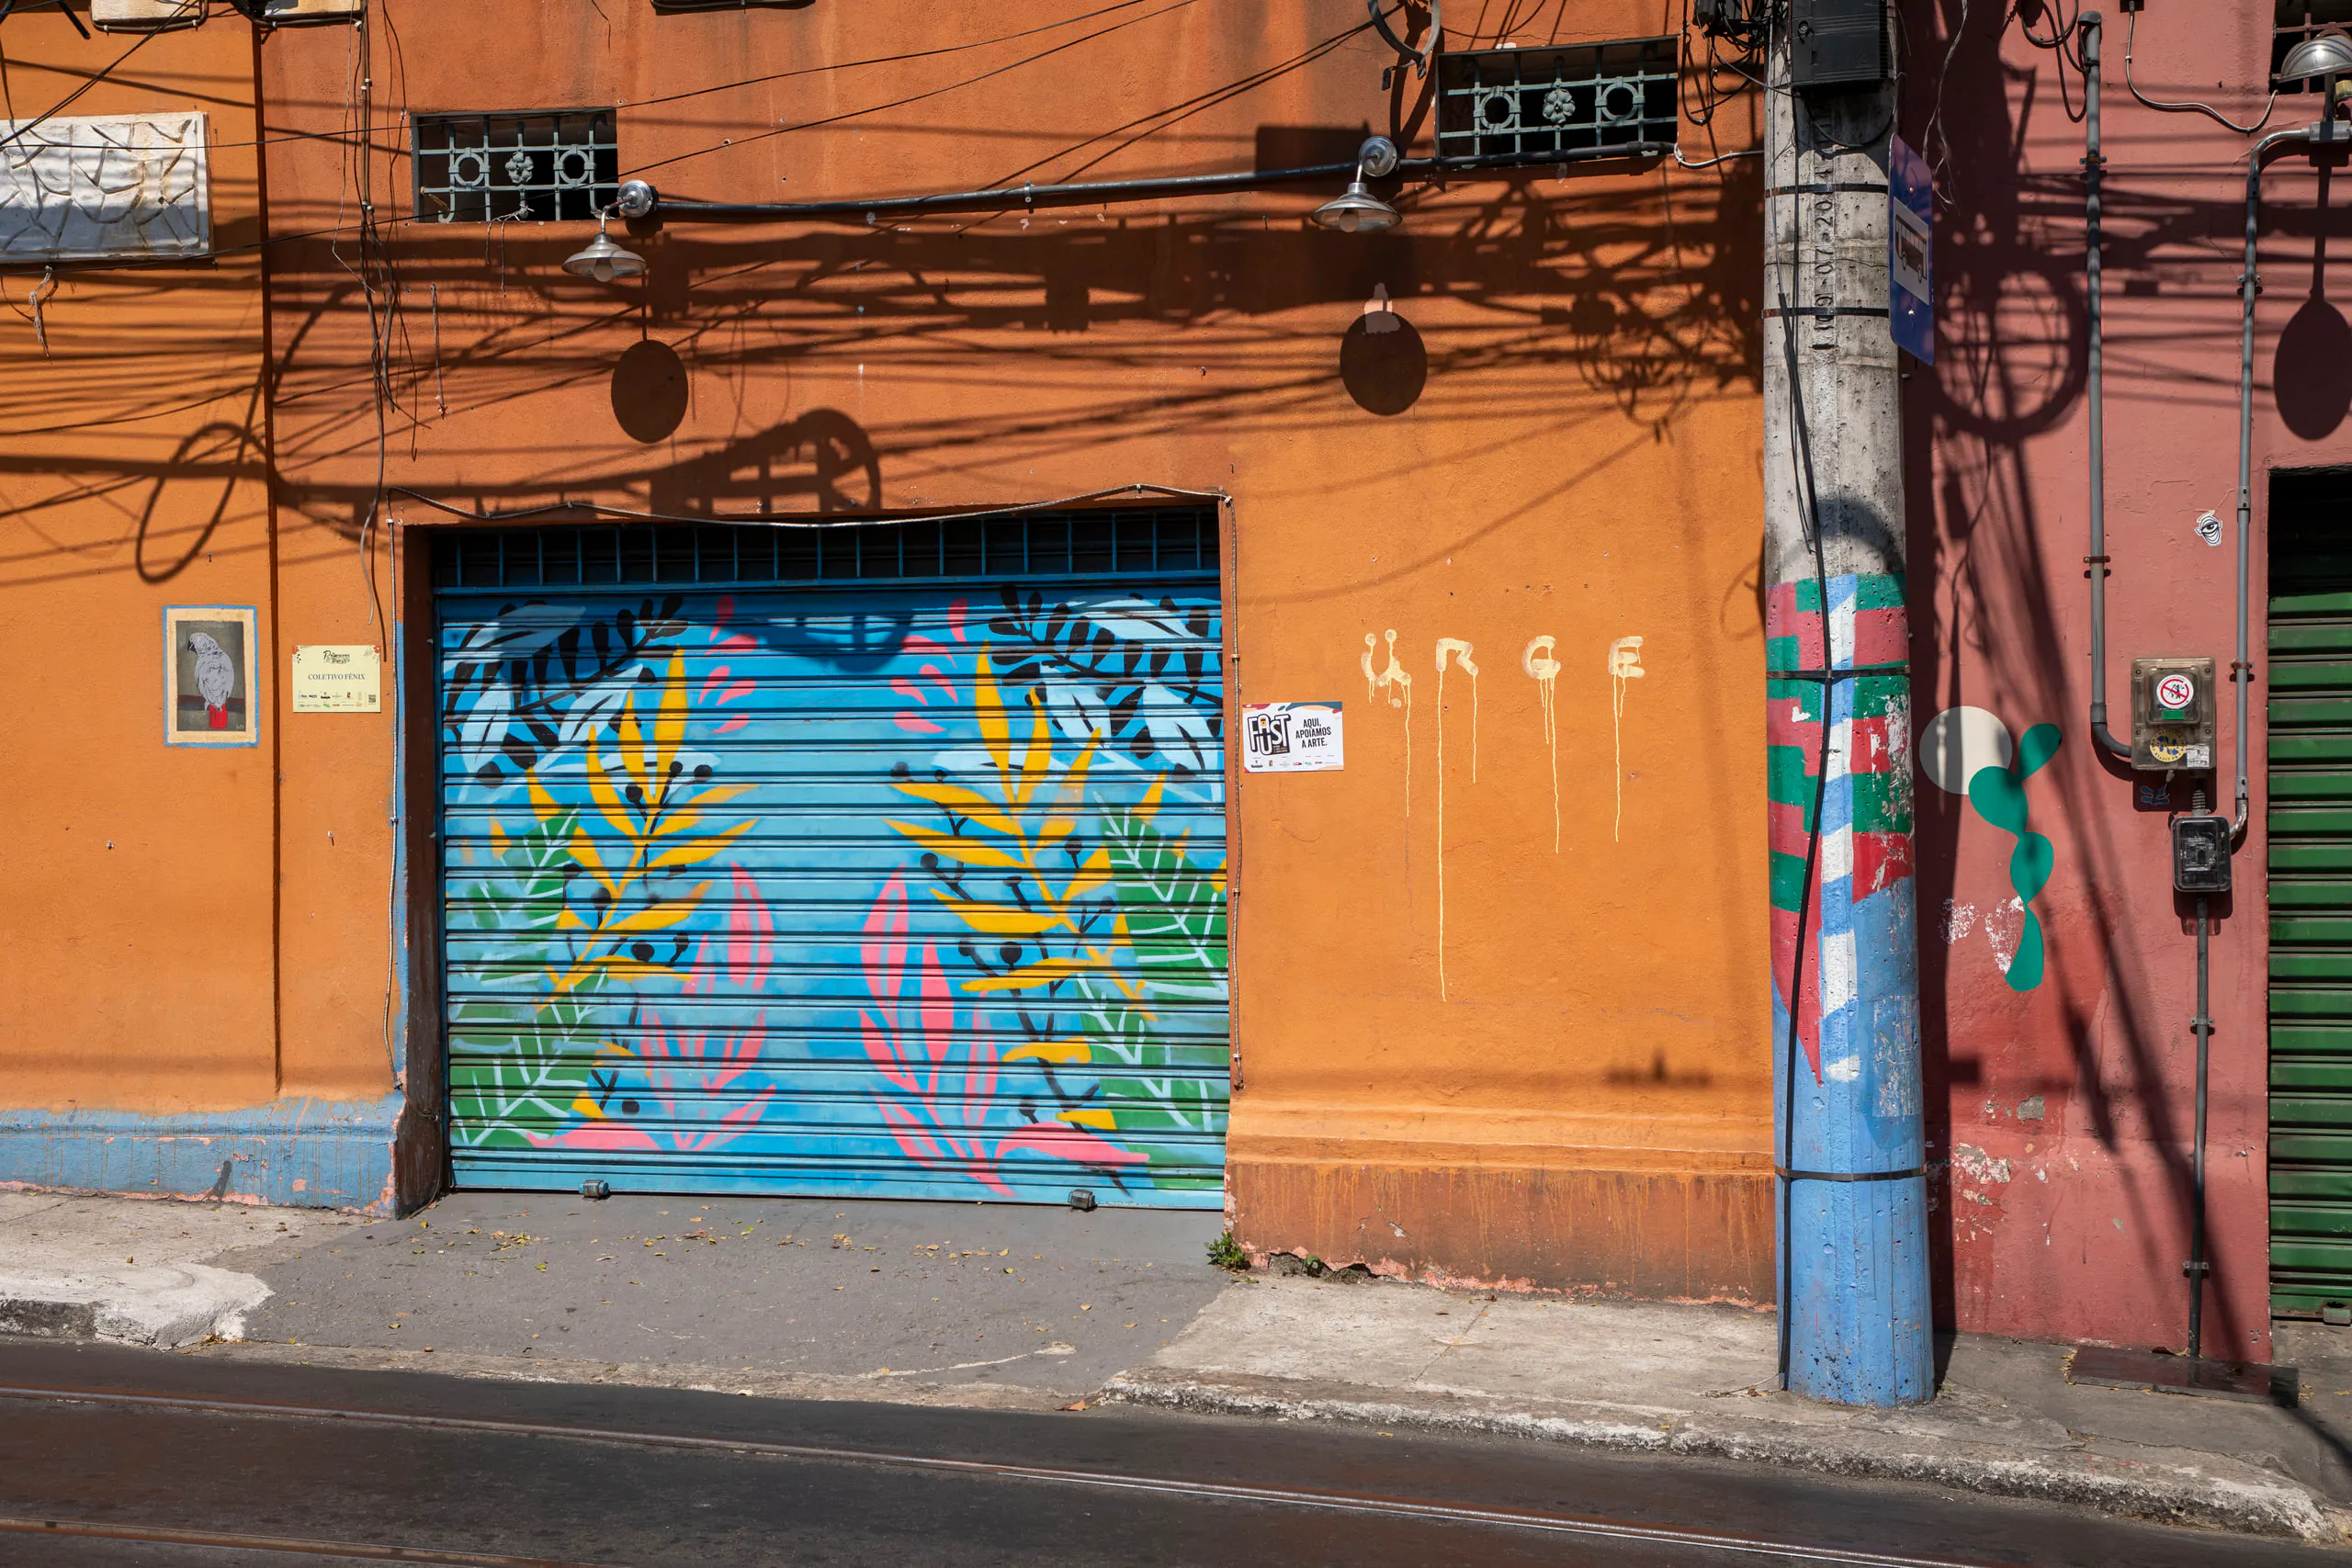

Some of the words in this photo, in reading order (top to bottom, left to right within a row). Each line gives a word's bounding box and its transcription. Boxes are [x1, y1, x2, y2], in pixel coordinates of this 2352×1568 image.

[1295, 726, 1332, 739] APOIAMOS
[1301, 739, 1306, 749] A
[1307, 737, 1328, 748] ARTE.
